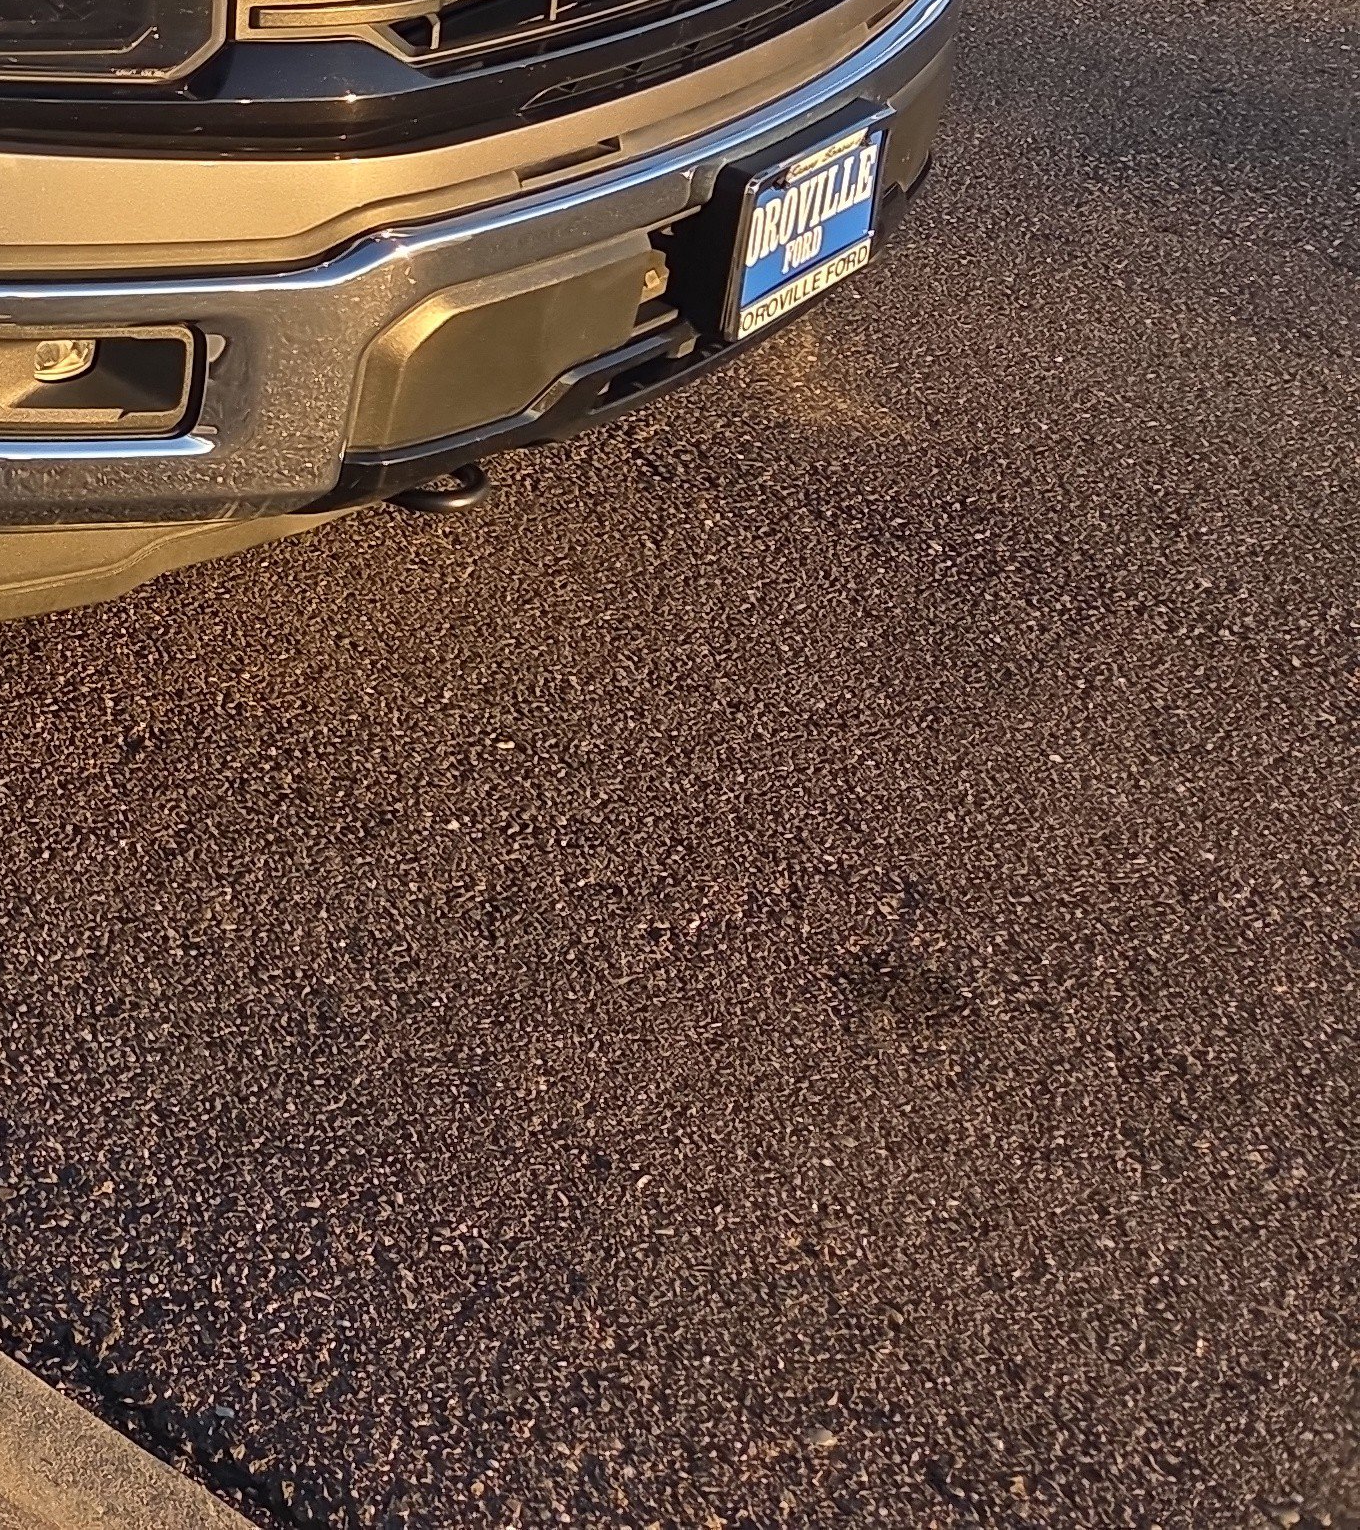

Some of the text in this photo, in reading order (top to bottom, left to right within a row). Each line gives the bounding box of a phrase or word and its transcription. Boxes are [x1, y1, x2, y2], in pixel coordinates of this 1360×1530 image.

[745, 144, 878, 268] OROVILLE
[781, 225, 823, 274] FORD
[742, 245, 869, 332] OROVILLE FORD
